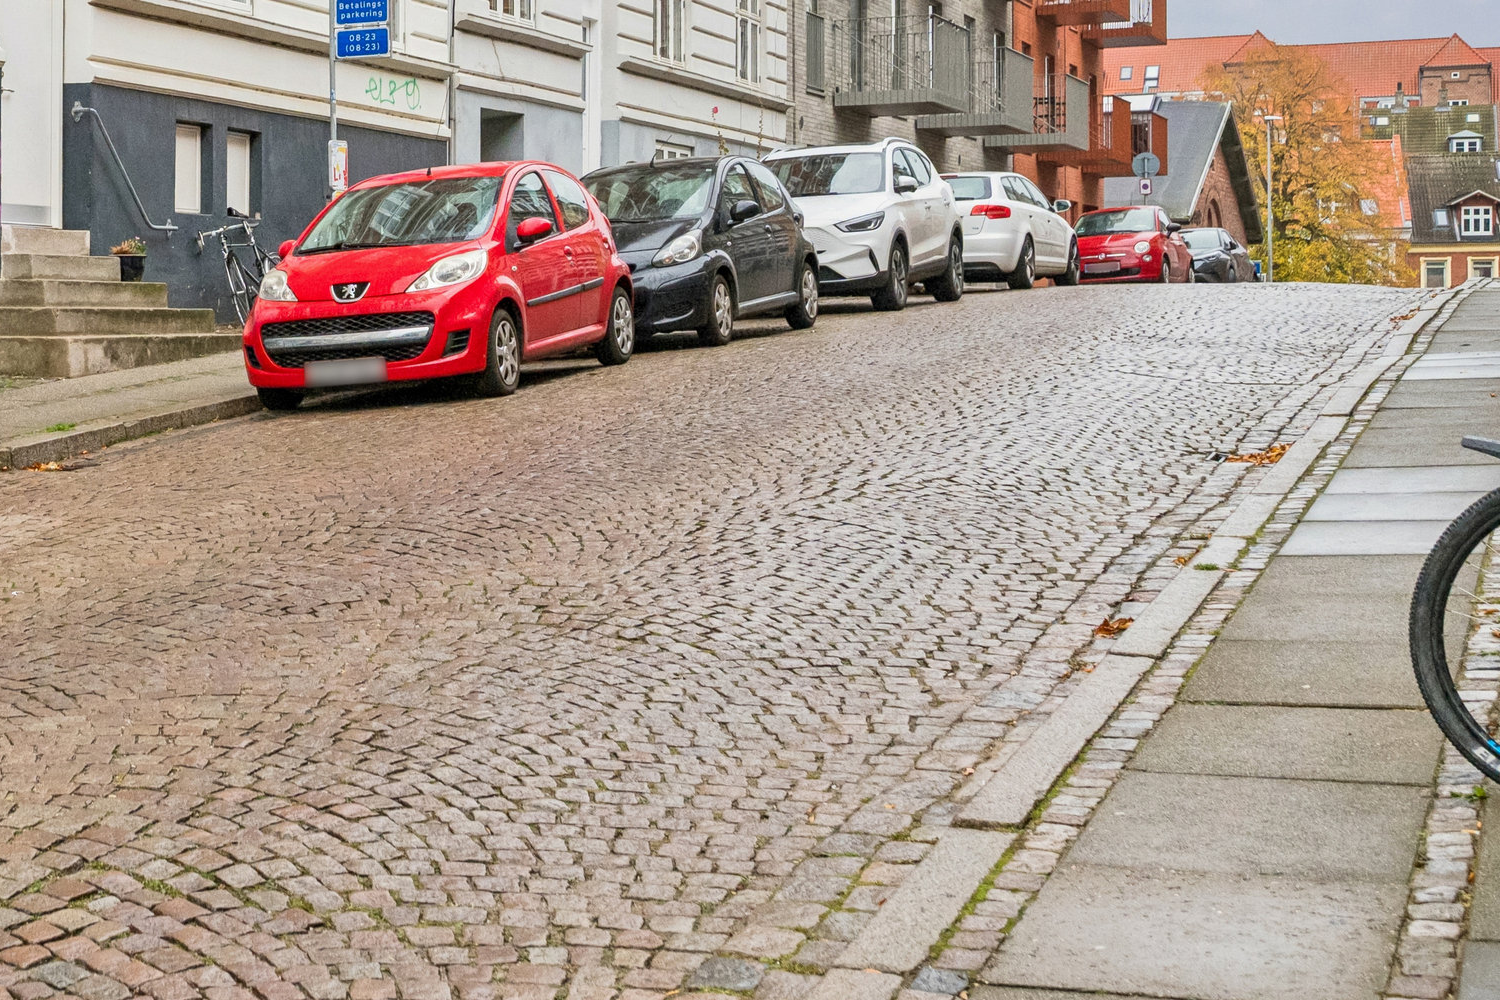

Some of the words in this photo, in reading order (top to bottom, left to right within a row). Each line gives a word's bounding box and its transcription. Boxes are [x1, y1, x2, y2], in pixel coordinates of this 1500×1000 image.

[338, 0, 386, 11] Betalings-
[340, 9, 384, 21] parkering
[348, 32, 377, 43] 08-23
[344, 42, 381, 53] (08-23)
